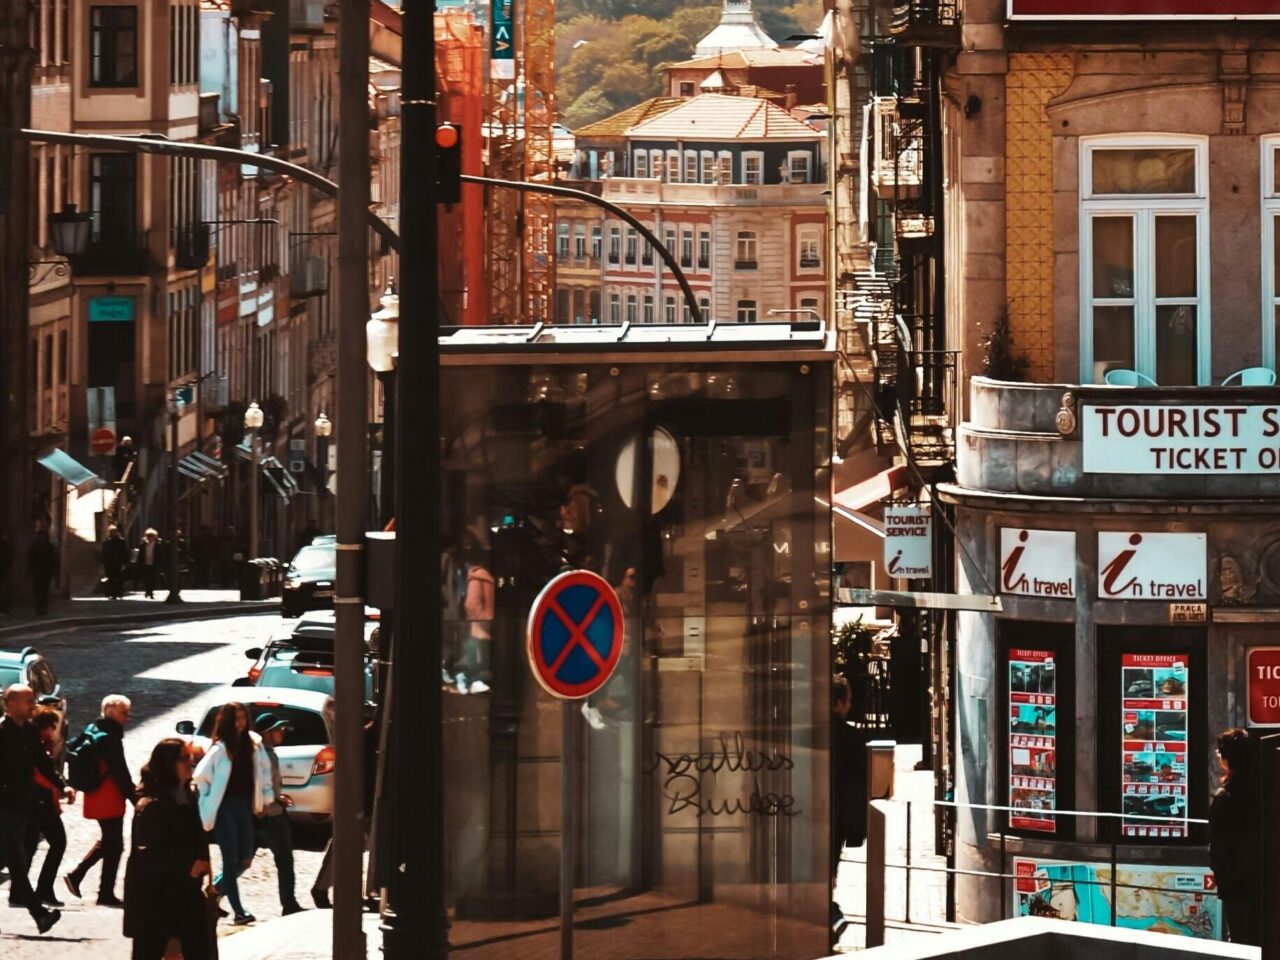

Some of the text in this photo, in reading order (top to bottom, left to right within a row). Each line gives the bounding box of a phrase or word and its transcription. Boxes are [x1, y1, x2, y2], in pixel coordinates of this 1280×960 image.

[1095, 408, 1247, 438] TOURIST
[1150, 447, 1247, 470] TICKET
[886, 515, 930, 525] TOURIST
[886, 527, 927, 537] SERVICE
[906, 565, 929, 574] travel
[1033, 577, 1073, 597] travel
[1150, 579, 1203, 597] travel
